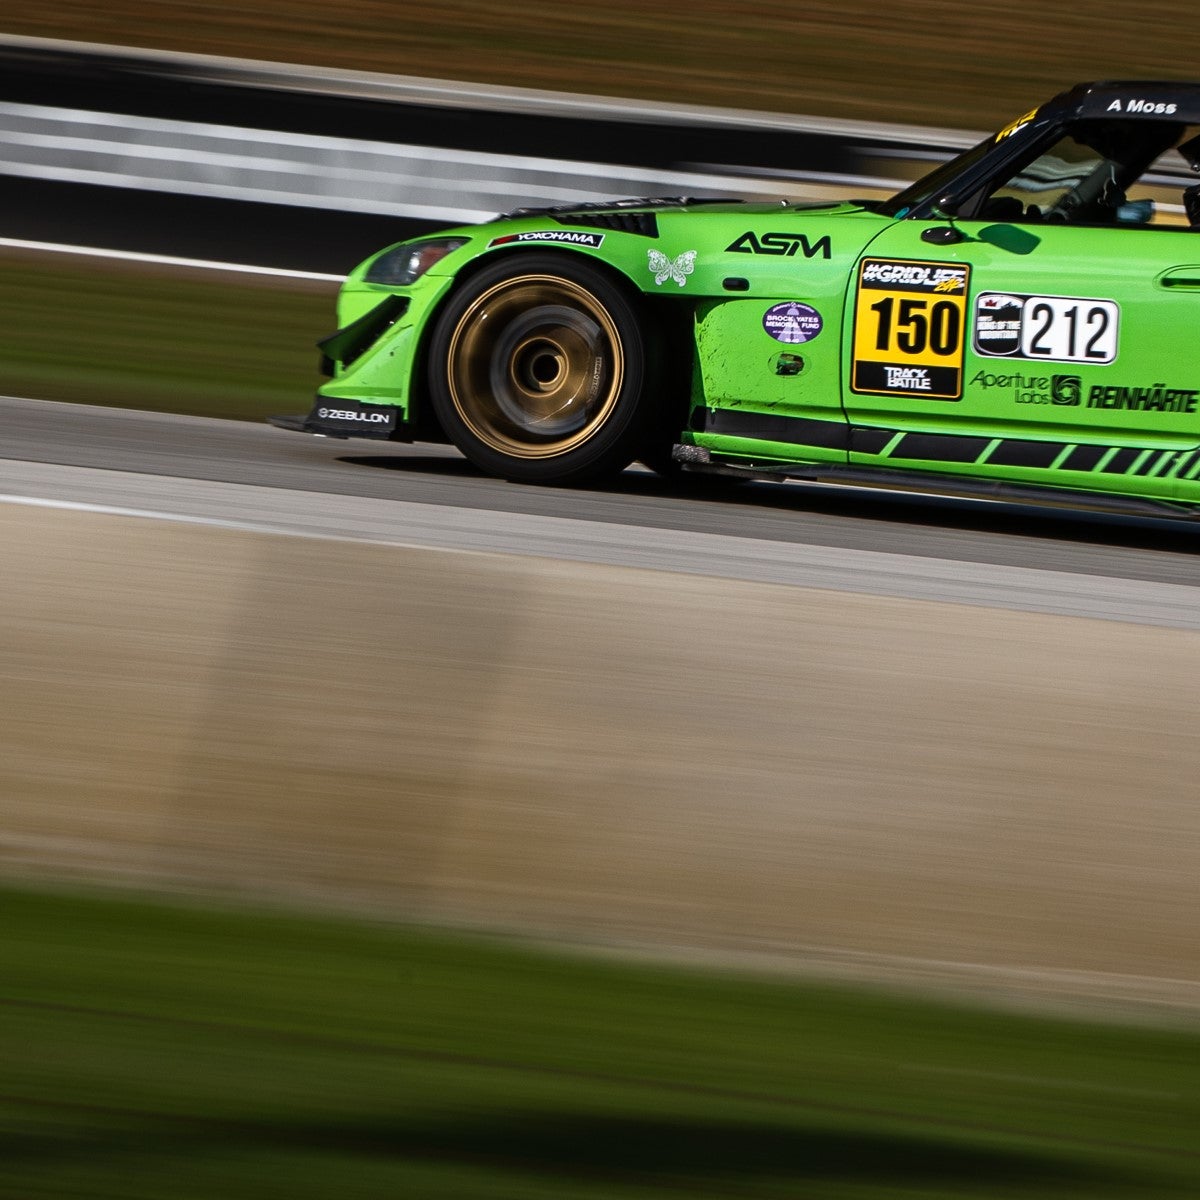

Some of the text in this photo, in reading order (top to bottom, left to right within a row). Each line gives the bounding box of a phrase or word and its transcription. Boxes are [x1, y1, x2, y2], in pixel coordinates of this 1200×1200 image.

[1107, 99, 1178, 115] A Moss
[518, 231, 595, 245] YOKOHAMA
[724, 230, 832, 260] ASM
[870, 297, 961, 357] 150
[1029, 302, 1109, 359] 212
[883, 366, 928, 379] TRACK
[968, 370, 1049, 389] Aperture
[886, 377, 932, 390] BATTLE
[1015, 389, 1049, 405] Labs
[328, 409, 390, 424] ZEBULON
